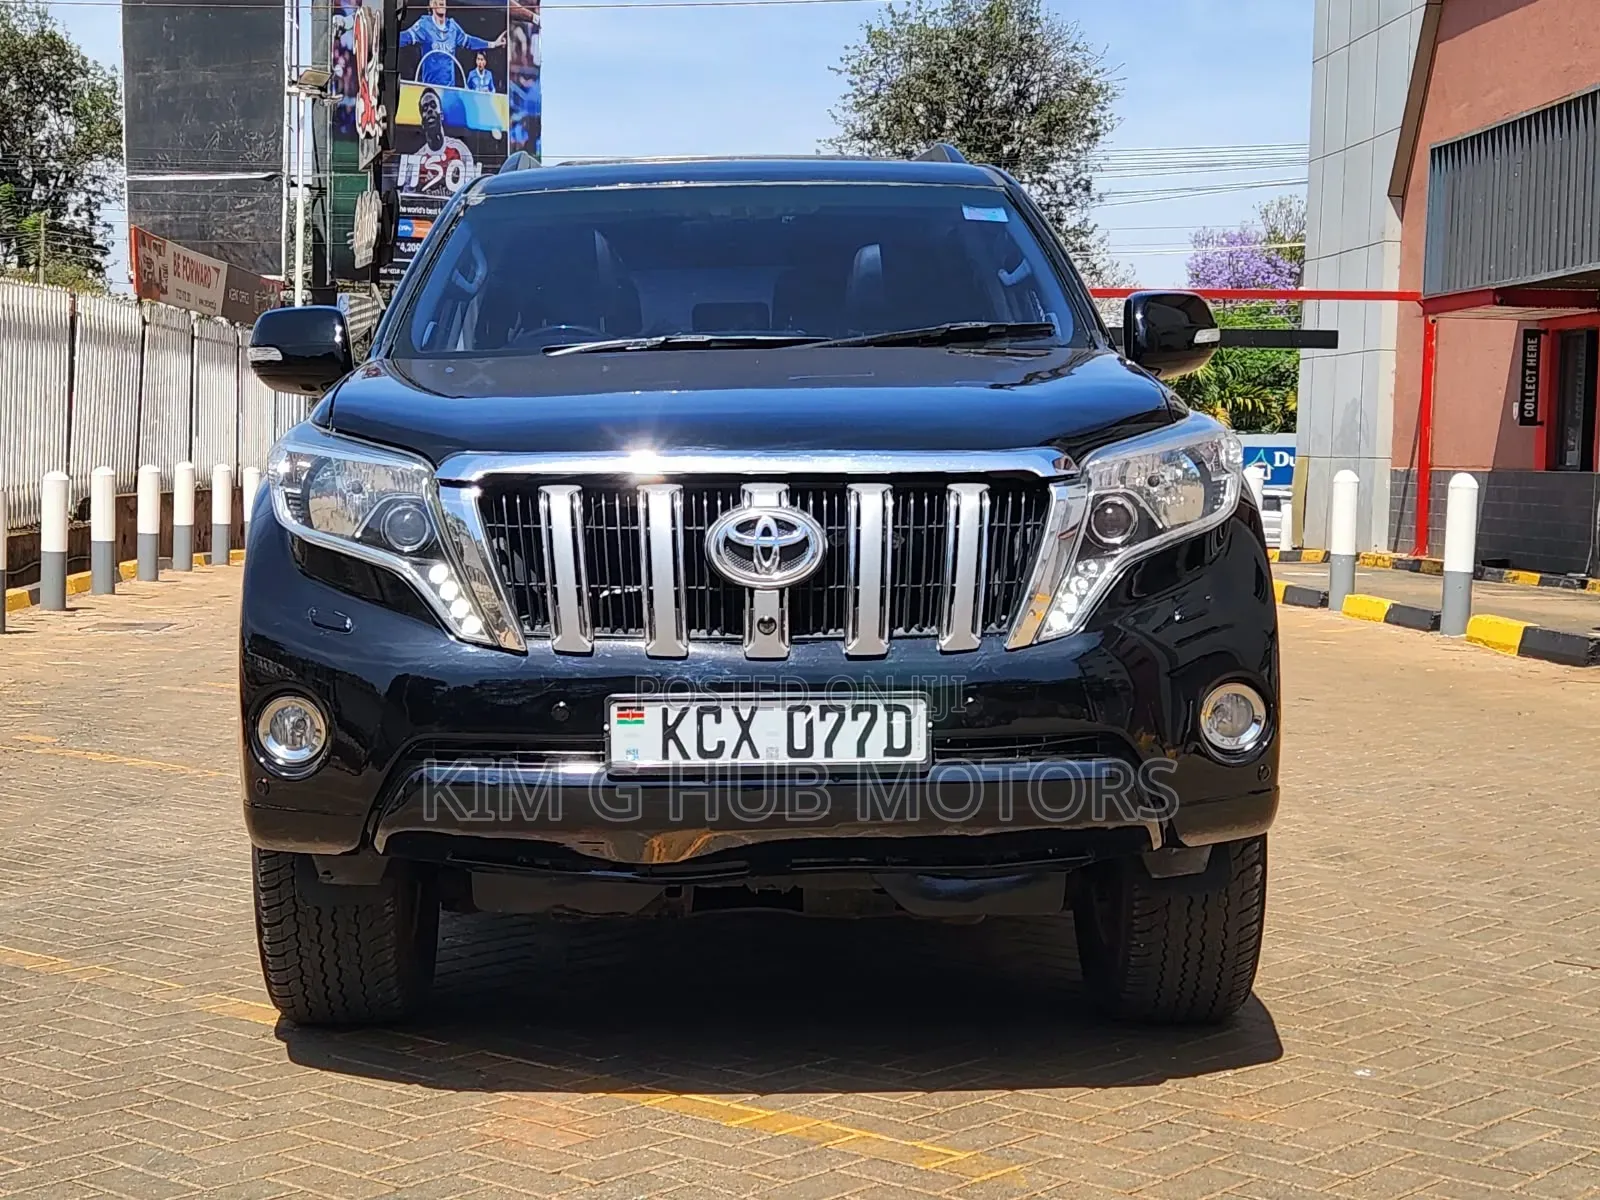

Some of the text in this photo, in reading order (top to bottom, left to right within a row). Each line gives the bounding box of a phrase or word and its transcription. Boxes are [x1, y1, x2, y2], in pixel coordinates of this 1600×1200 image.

[397, 154, 444, 191] IT'S
[407, 206, 425, 215] world's
[173, 251, 181, 278] BE
[182, 256, 212, 289] FORWARD
[1523, 337, 1538, 418] COLLECT HERE
[661, 705, 760, 760] KCX
[786, 704, 912, 759] 077D
